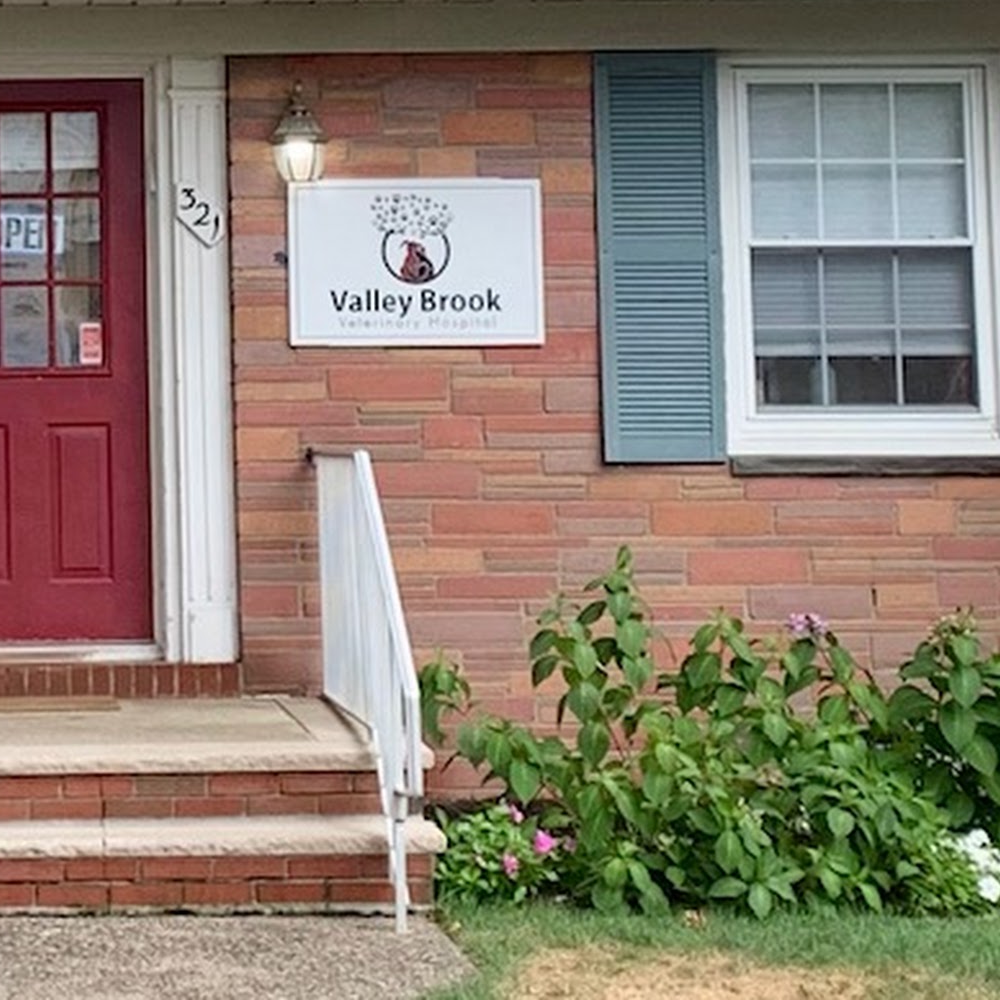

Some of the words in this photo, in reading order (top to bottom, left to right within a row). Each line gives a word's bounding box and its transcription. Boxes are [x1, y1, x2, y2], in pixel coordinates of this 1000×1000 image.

[180, 188, 220, 241] 321
[330, 288, 413, 318] Valley
[420, 287, 502, 312] Brook
[339, 317, 420, 330] Veterinary
[428, 316, 498, 330] Hospital
